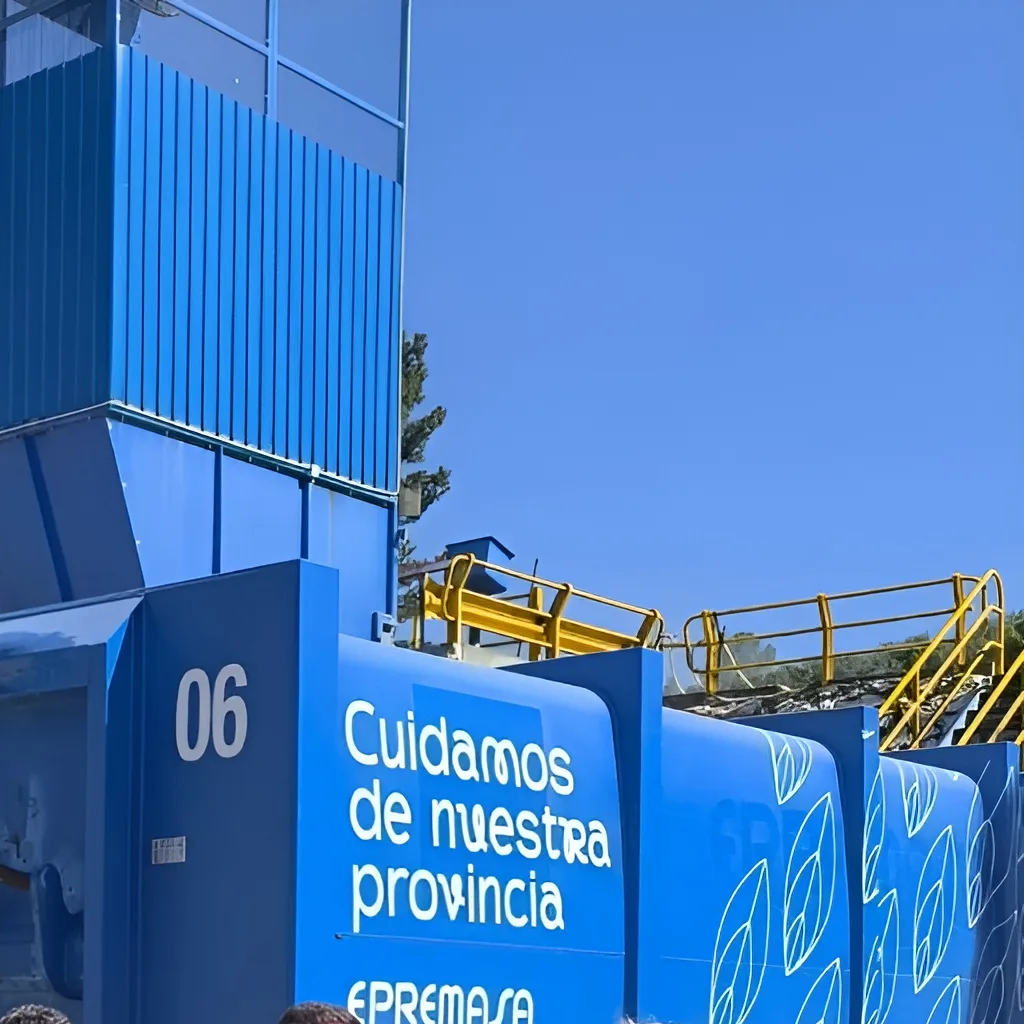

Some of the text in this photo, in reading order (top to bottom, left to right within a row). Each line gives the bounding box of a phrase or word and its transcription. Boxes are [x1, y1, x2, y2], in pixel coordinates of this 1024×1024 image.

[176, 663, 248, 761] 06
[344, 699, 575, 796] Cuidamos
[349, 778, 413, 846] de
[352, 863, 565, 934] provincia
